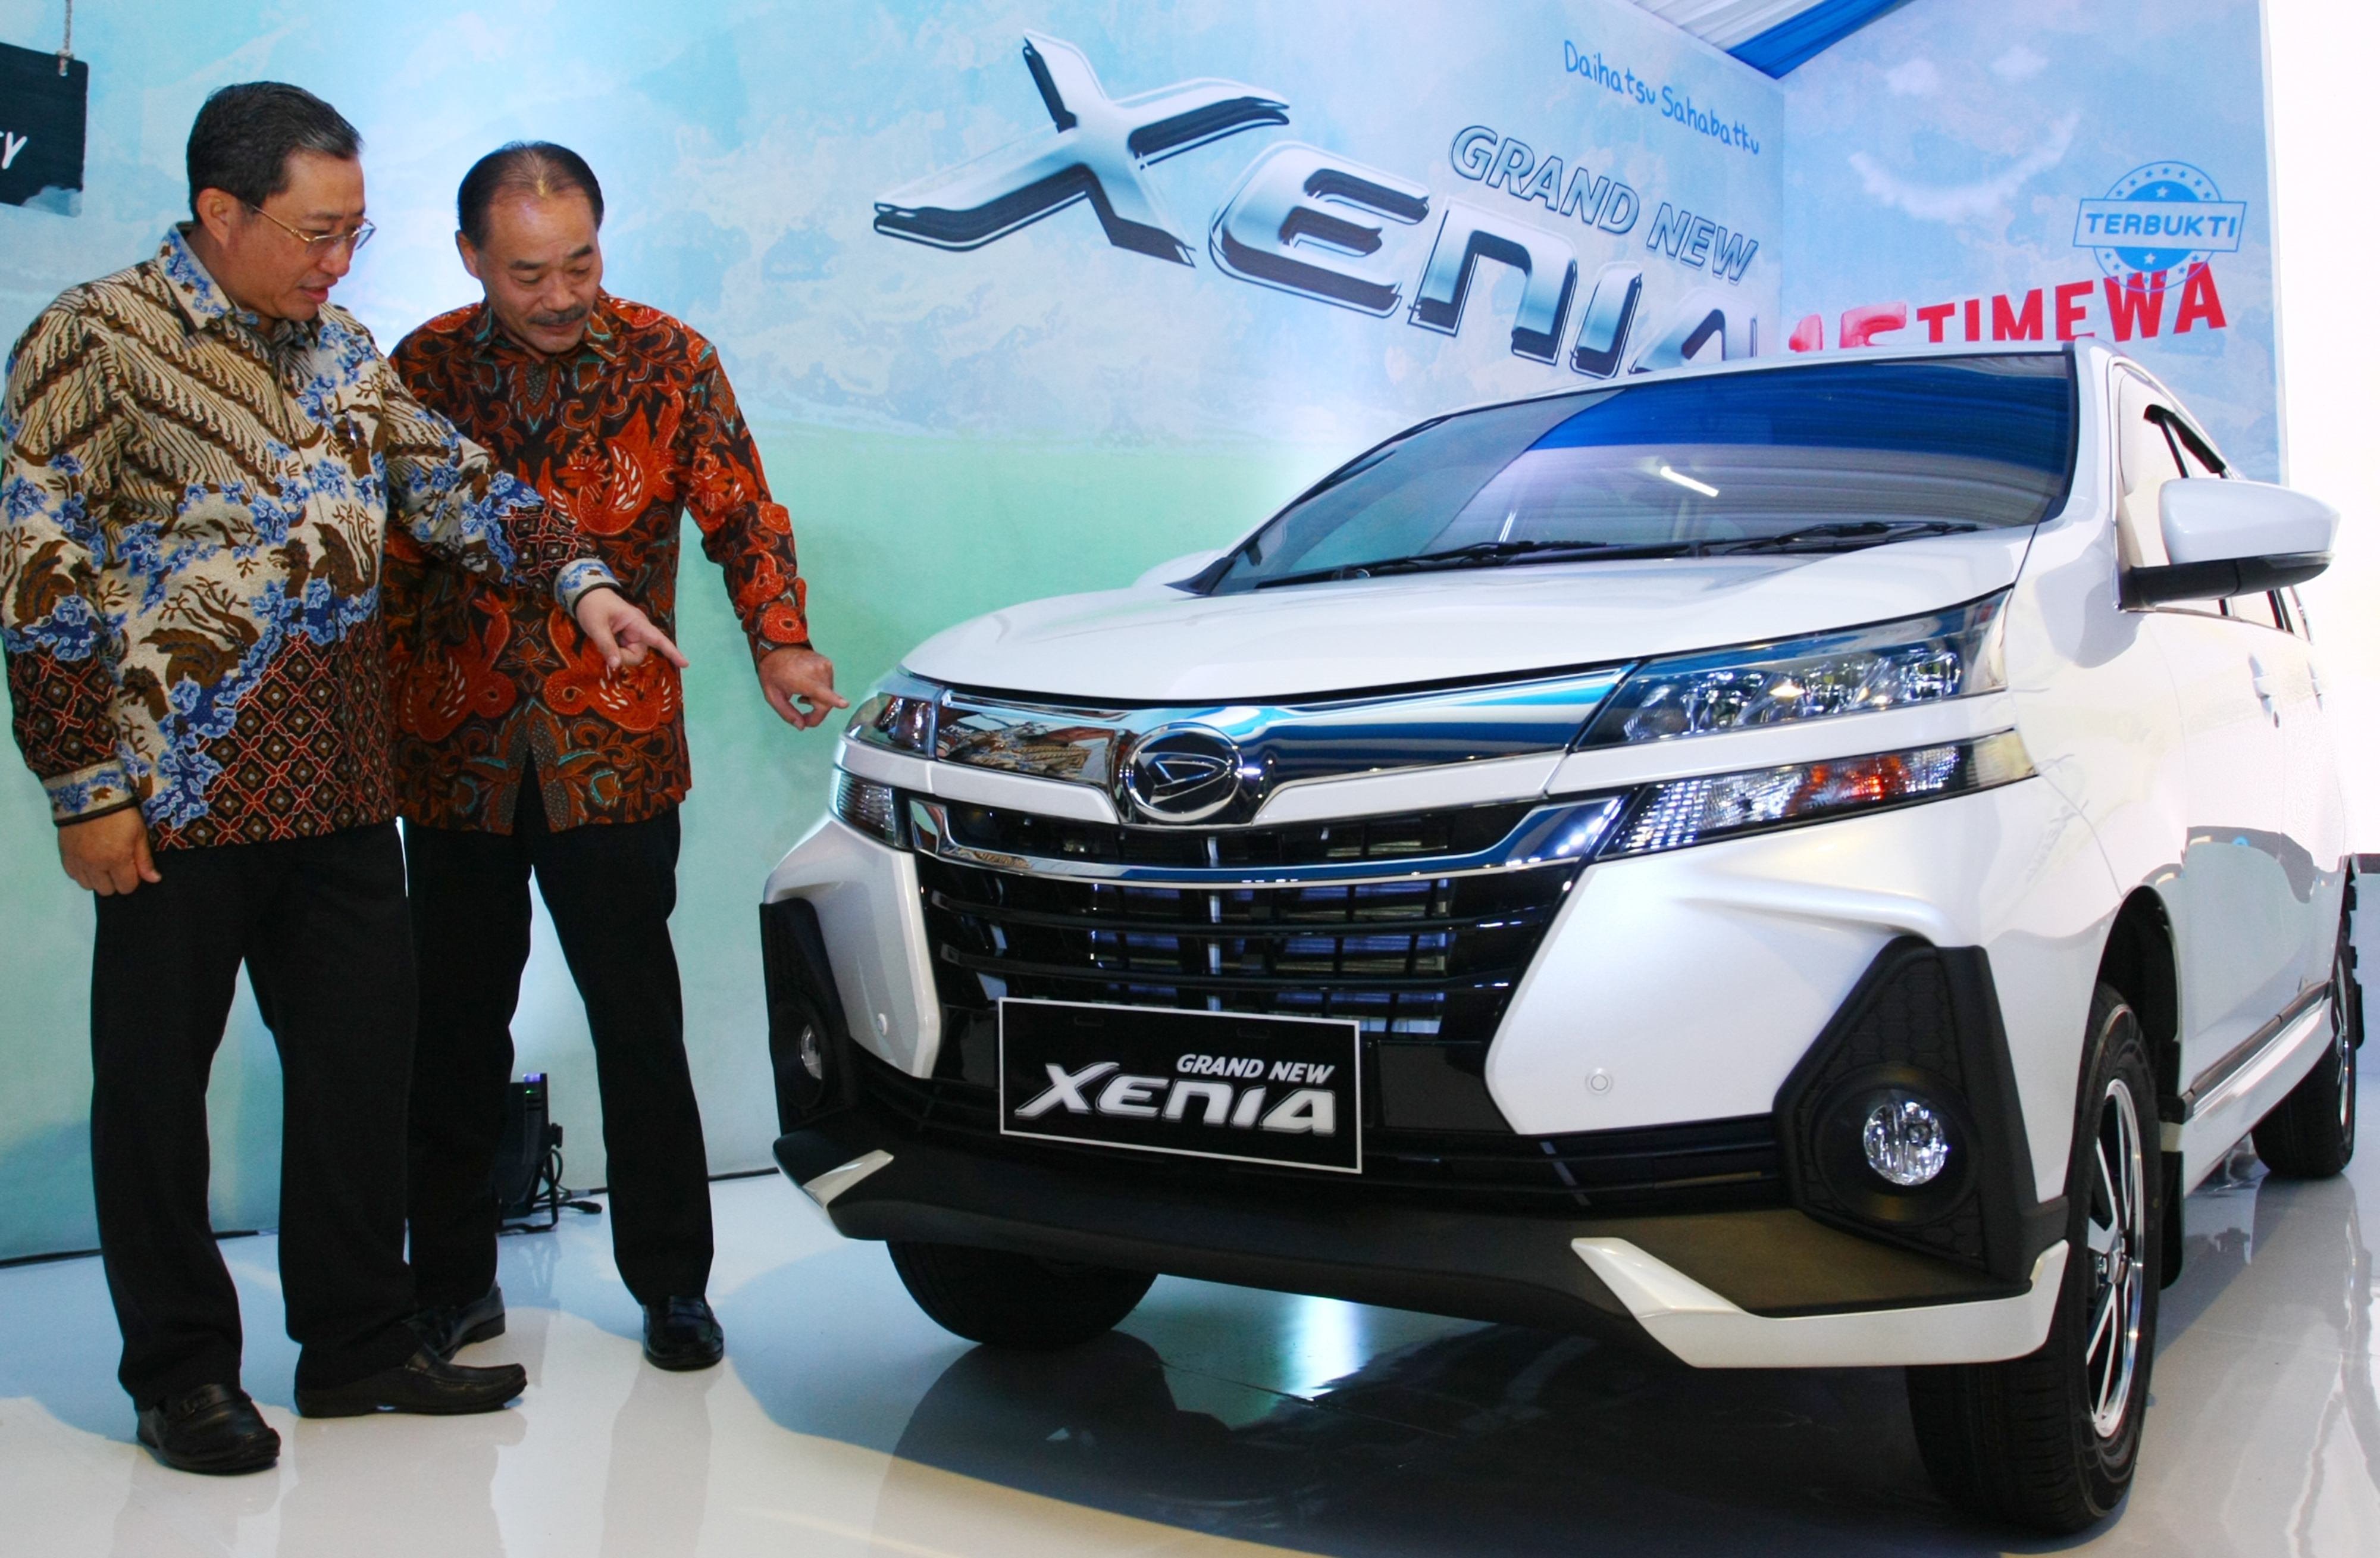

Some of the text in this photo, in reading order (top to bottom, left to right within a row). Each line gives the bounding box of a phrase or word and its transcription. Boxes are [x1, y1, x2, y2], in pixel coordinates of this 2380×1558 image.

[1564, 39, 1759, 155] Daihatsu Sahabatku
[0, 130, 27, 170] Y
[1449, 125, 1759, 286] GRAND NEW
[2085, 213, 2236, 238] TERBUKTI
[1176, 1053, 1335, 1085] GRAND NEW
[1014, 1061, 1337, 1137] XENIA
